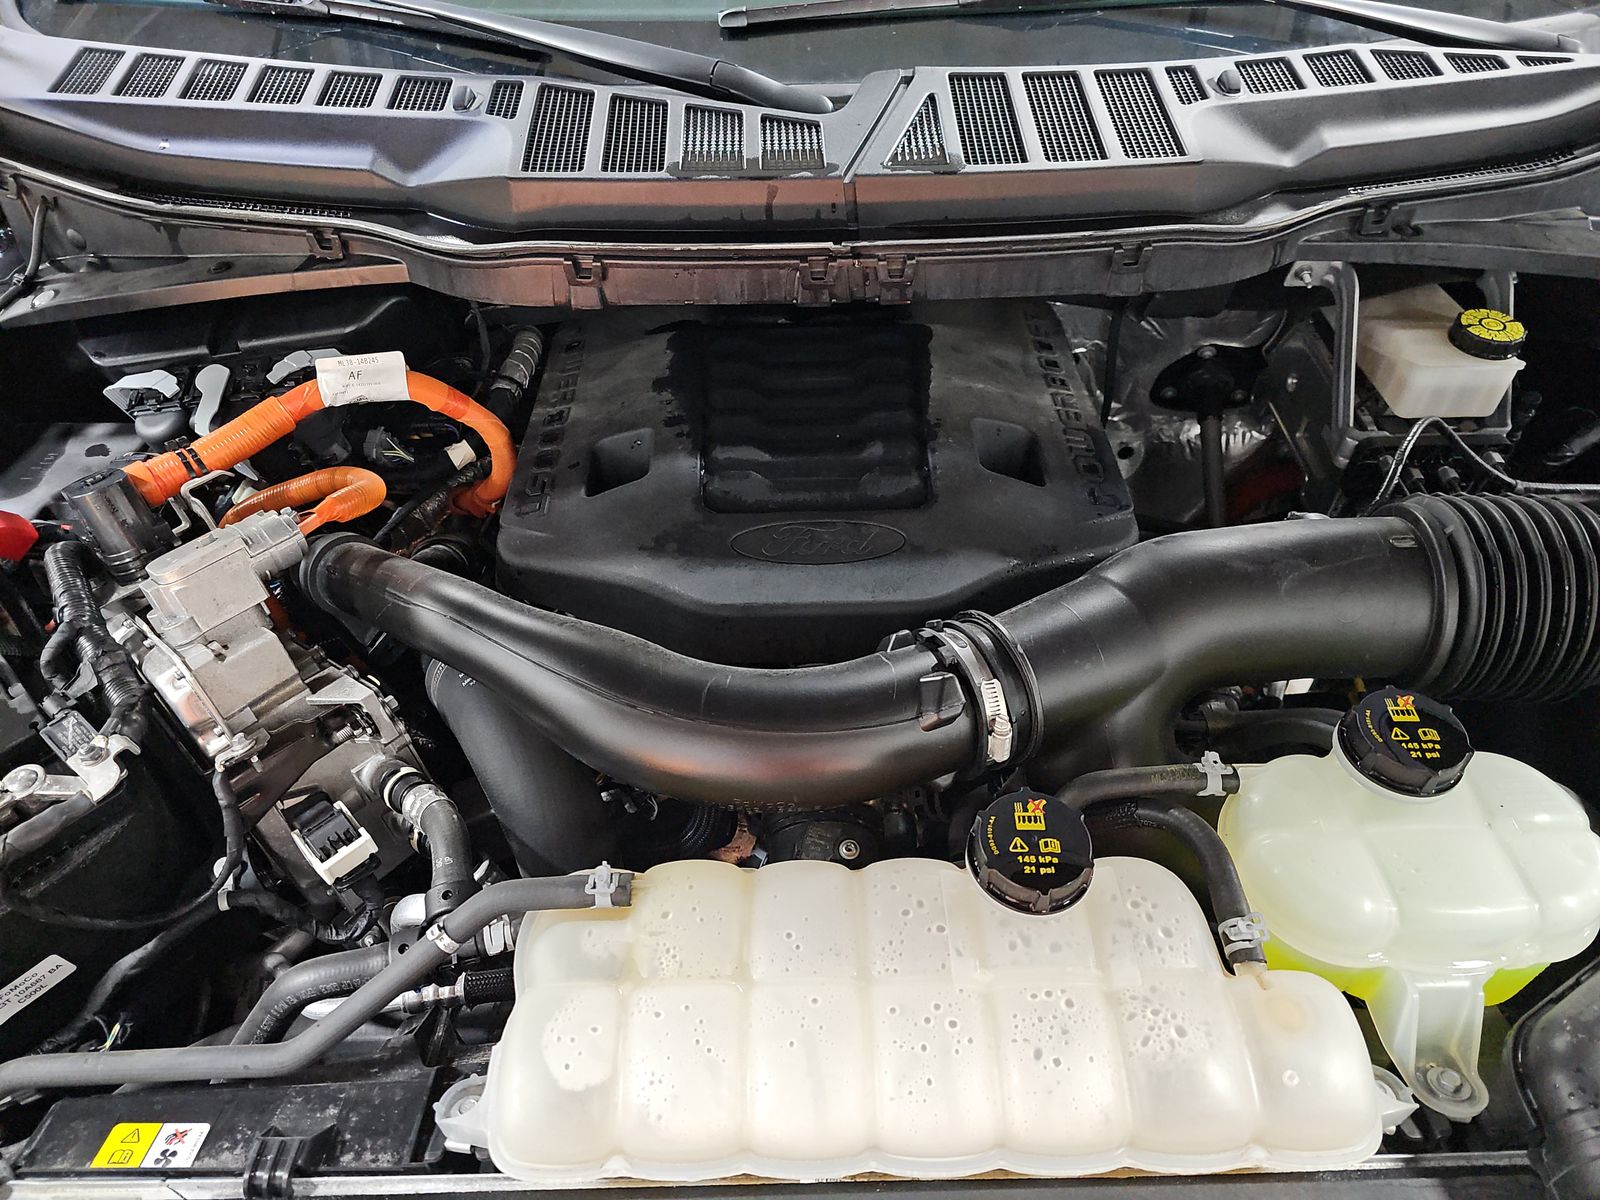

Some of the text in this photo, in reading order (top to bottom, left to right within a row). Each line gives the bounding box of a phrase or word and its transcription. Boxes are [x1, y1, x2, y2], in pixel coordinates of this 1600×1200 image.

[348, 370, 363, 380] AF
[761, 522, 877, 557] Ford
[1401, 742, 1441, 750] 145 kPa
[1425, 751, 1440, 759] psi
[1017, 855, 1059, 864] 145 kPa
[1023, 866, 1055, 875] 21 psi
[48, 963, 63, 974] BA
